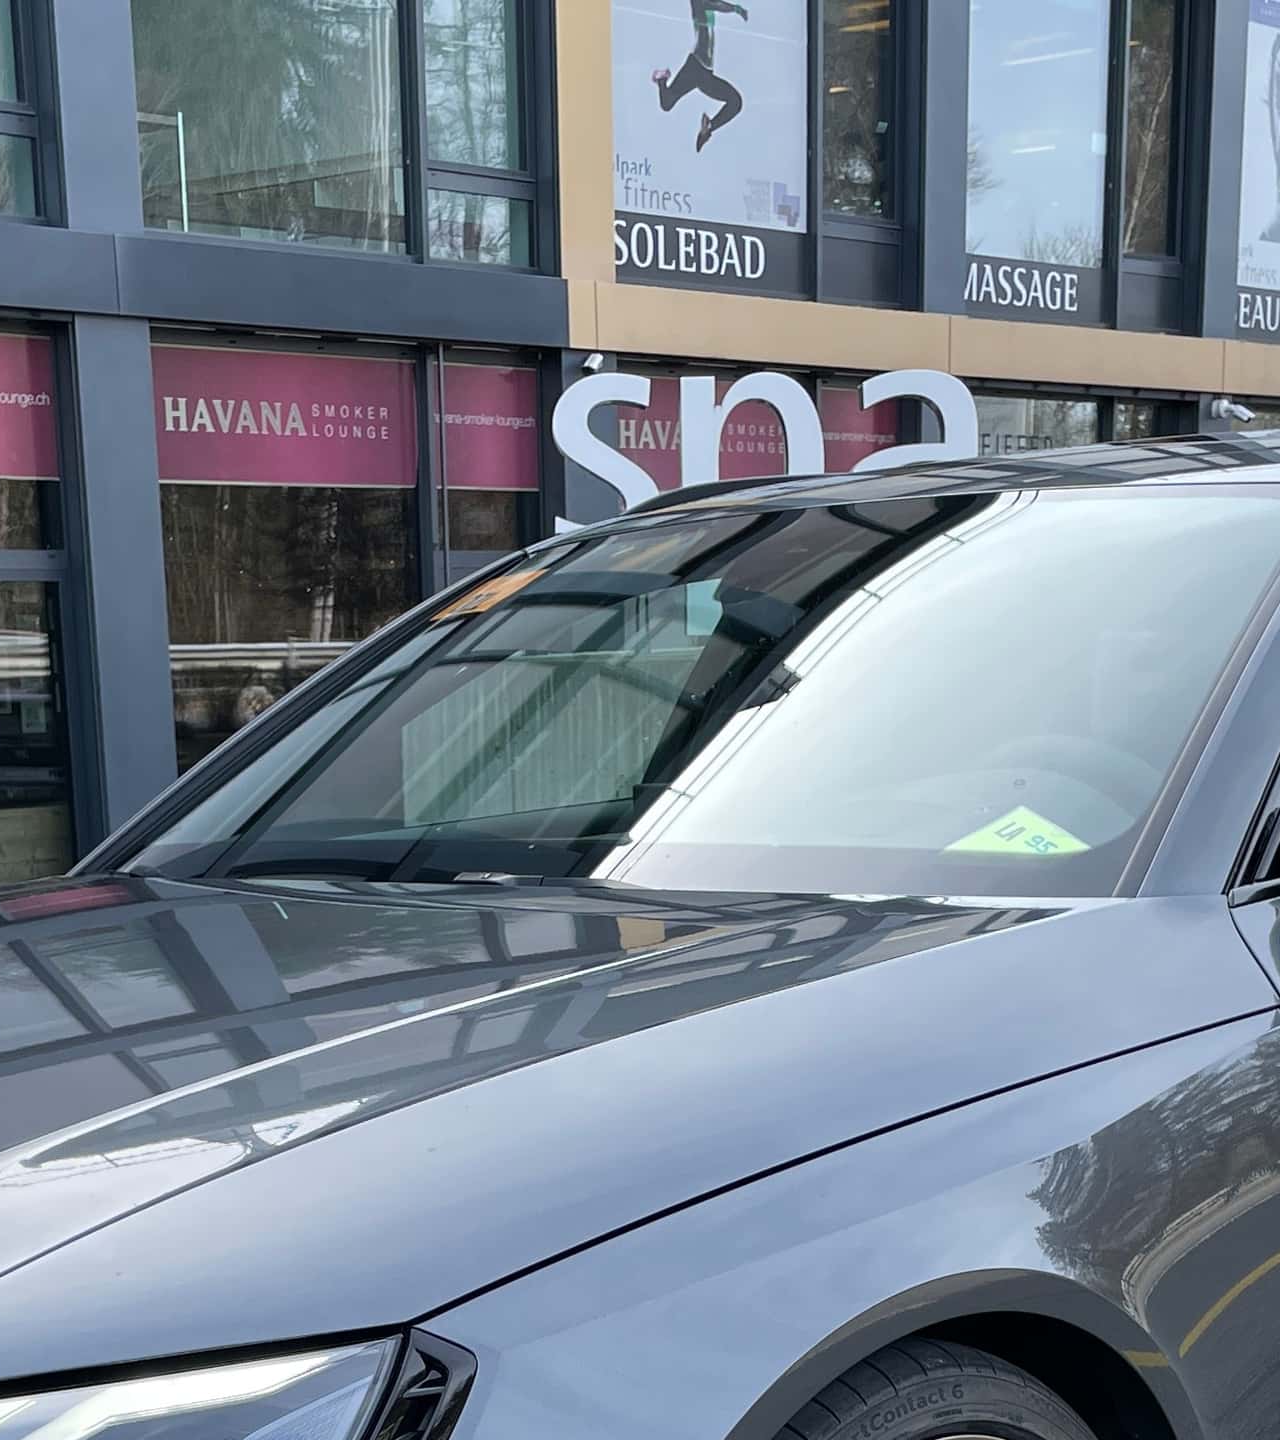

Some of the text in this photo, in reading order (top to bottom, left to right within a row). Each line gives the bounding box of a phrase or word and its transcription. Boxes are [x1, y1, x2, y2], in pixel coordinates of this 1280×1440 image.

[624, 178, 693, 214] fitness
[613, 219, 766, 279] SOLEBAD
[163, 396, 389, 438] HAVANA SMOKER
[312, 423, 390, 440] LOUNGE
[951, 1383, 965, 1400] 6
